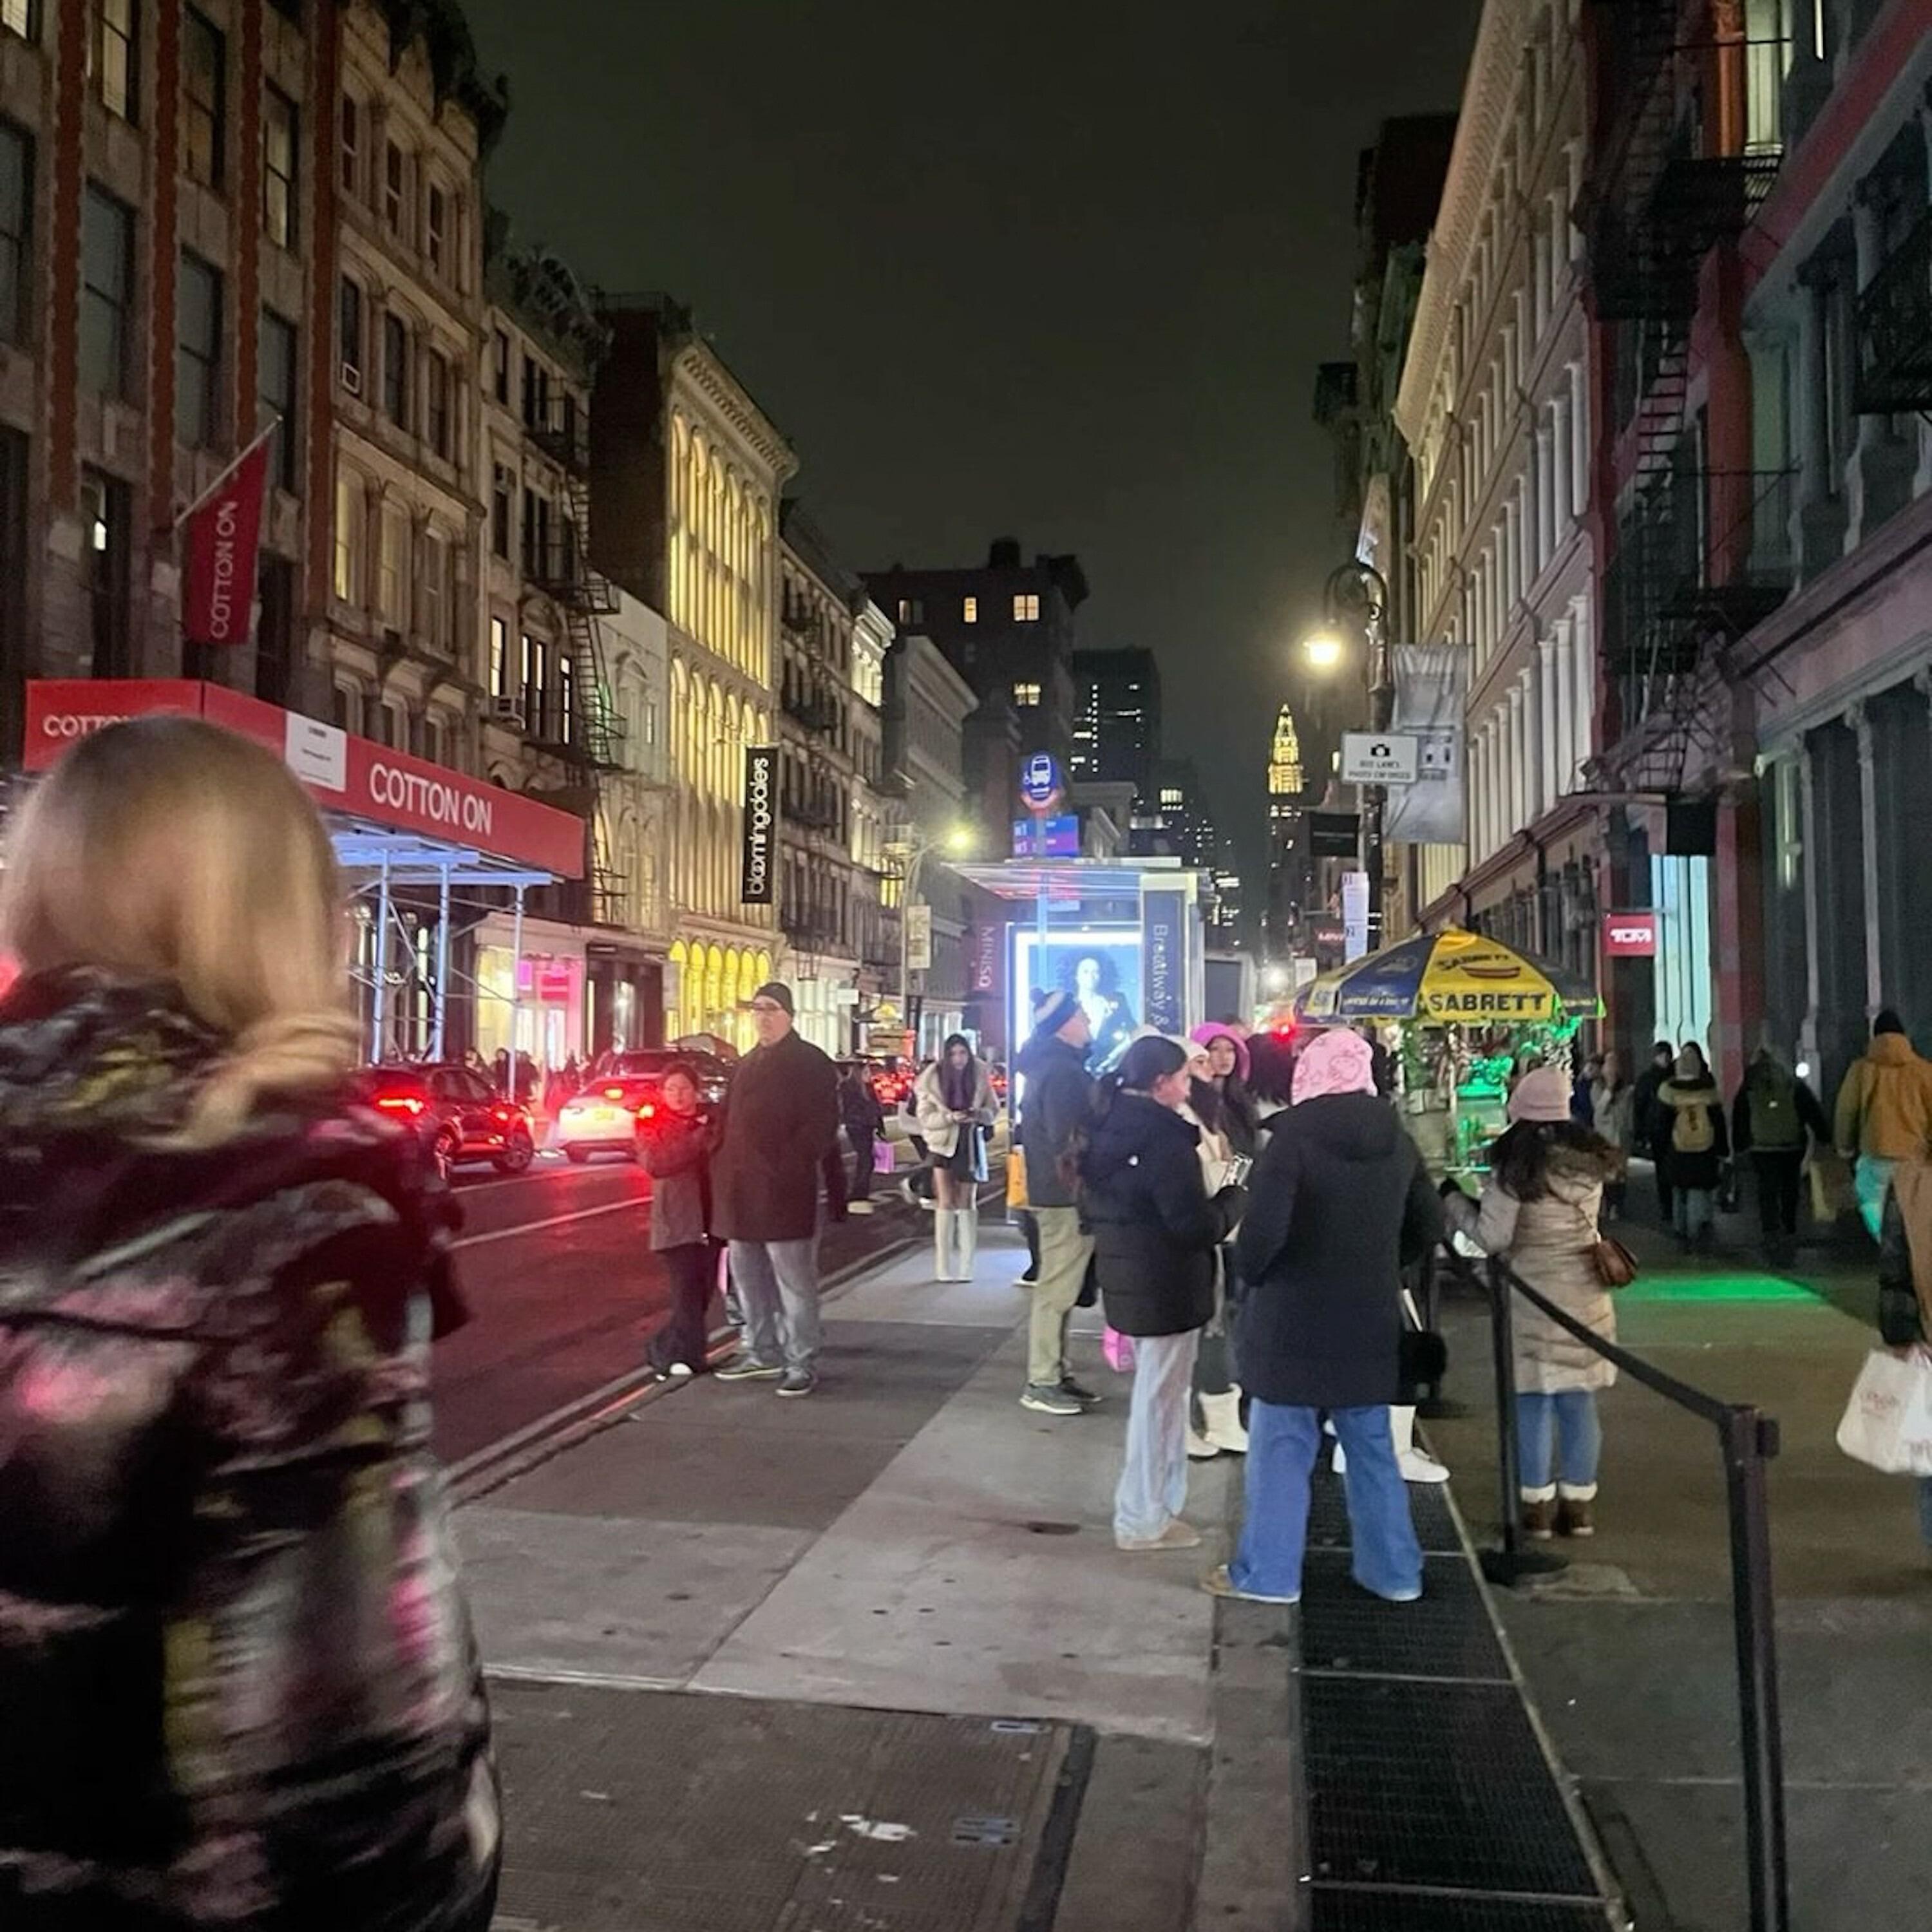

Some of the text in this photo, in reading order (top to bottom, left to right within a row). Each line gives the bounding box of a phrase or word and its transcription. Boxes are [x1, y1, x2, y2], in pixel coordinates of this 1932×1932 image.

[210, 500, 239, 639] COTTON ON
[43, 714, 131, 737] COTT
[370, 762, 493, 836] COTTON ON
[980, 926, 995, 987] MINISO
[1429, 993, 1546, 1012] SABRETT
